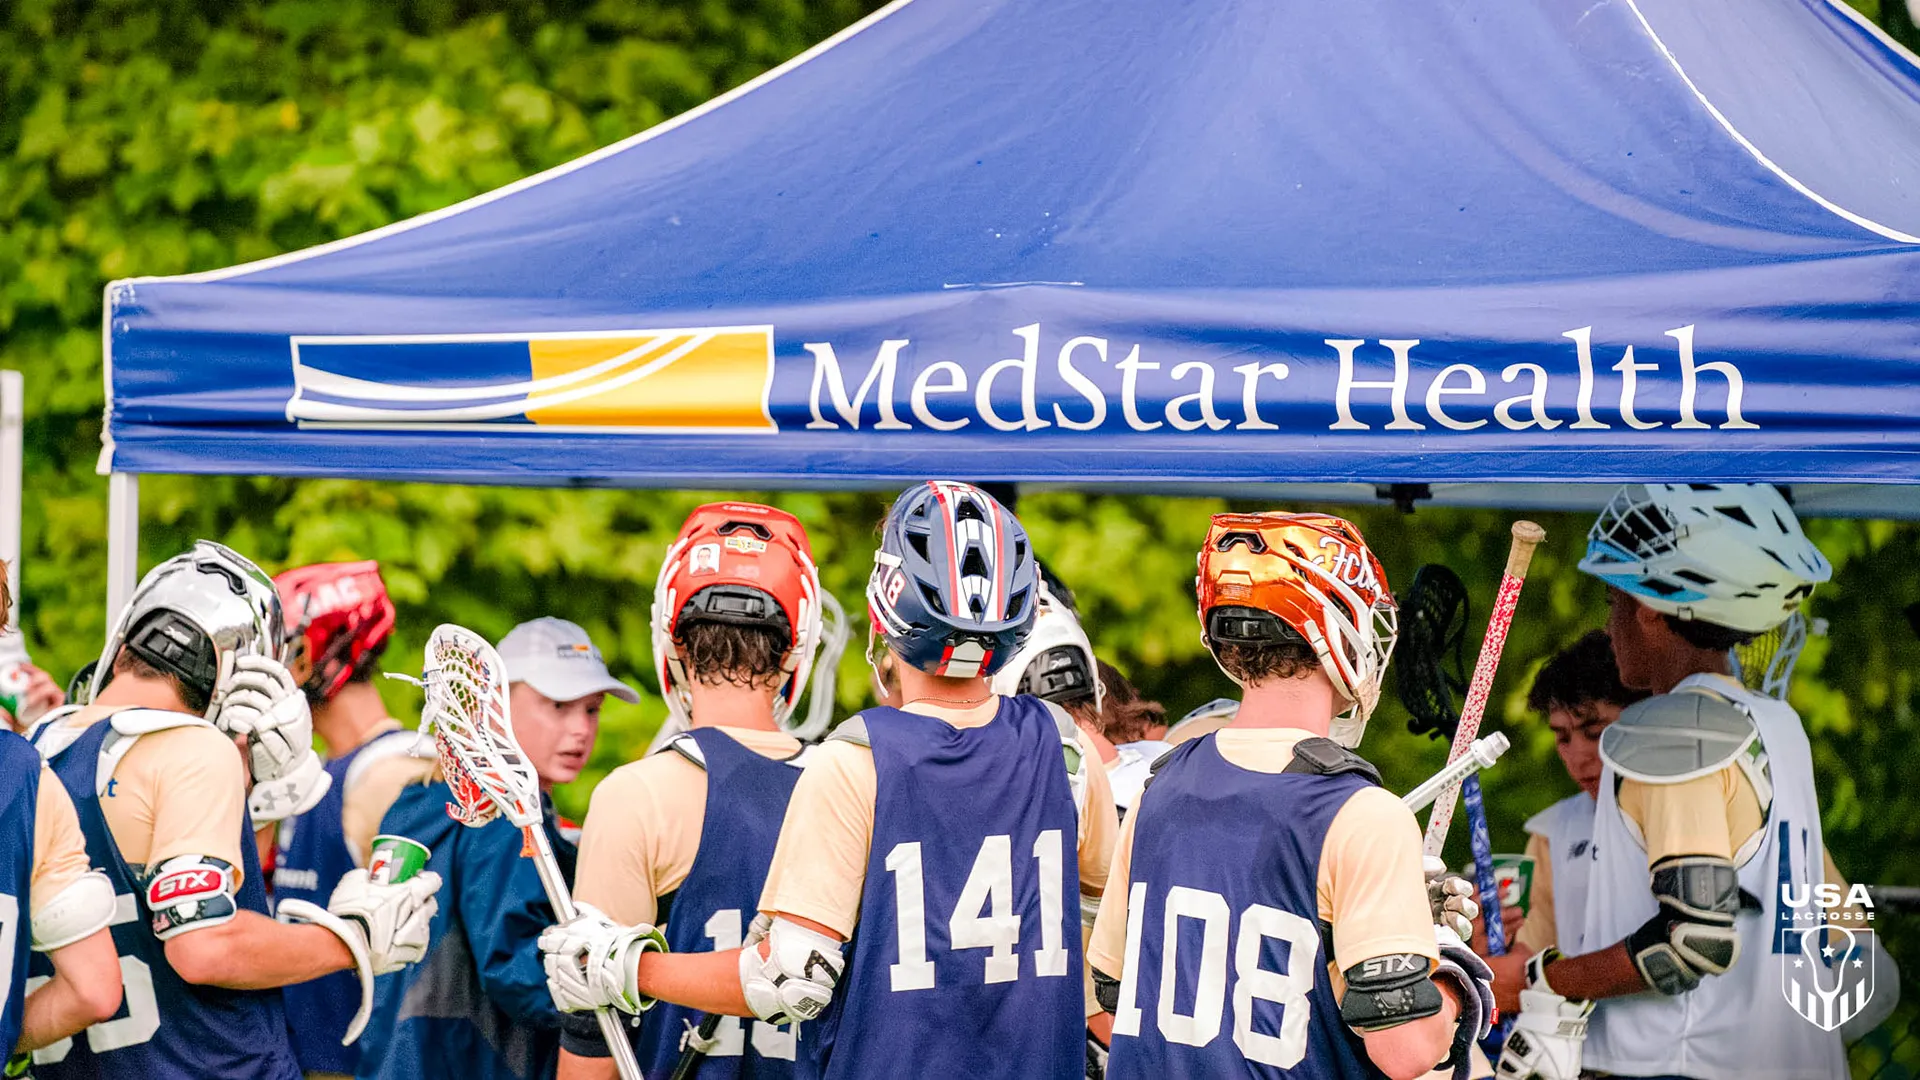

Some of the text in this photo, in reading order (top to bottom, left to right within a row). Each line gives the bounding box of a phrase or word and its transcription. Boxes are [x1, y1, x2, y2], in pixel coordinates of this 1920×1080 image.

[803, 322, 1761, 432] MedStar Health
[158, 870, 210, 898] STX
[885, 829, 1068, 992] 141
[1112, 882, 1320, 1070] 108
[1362, 953, 1416, 978] STX
